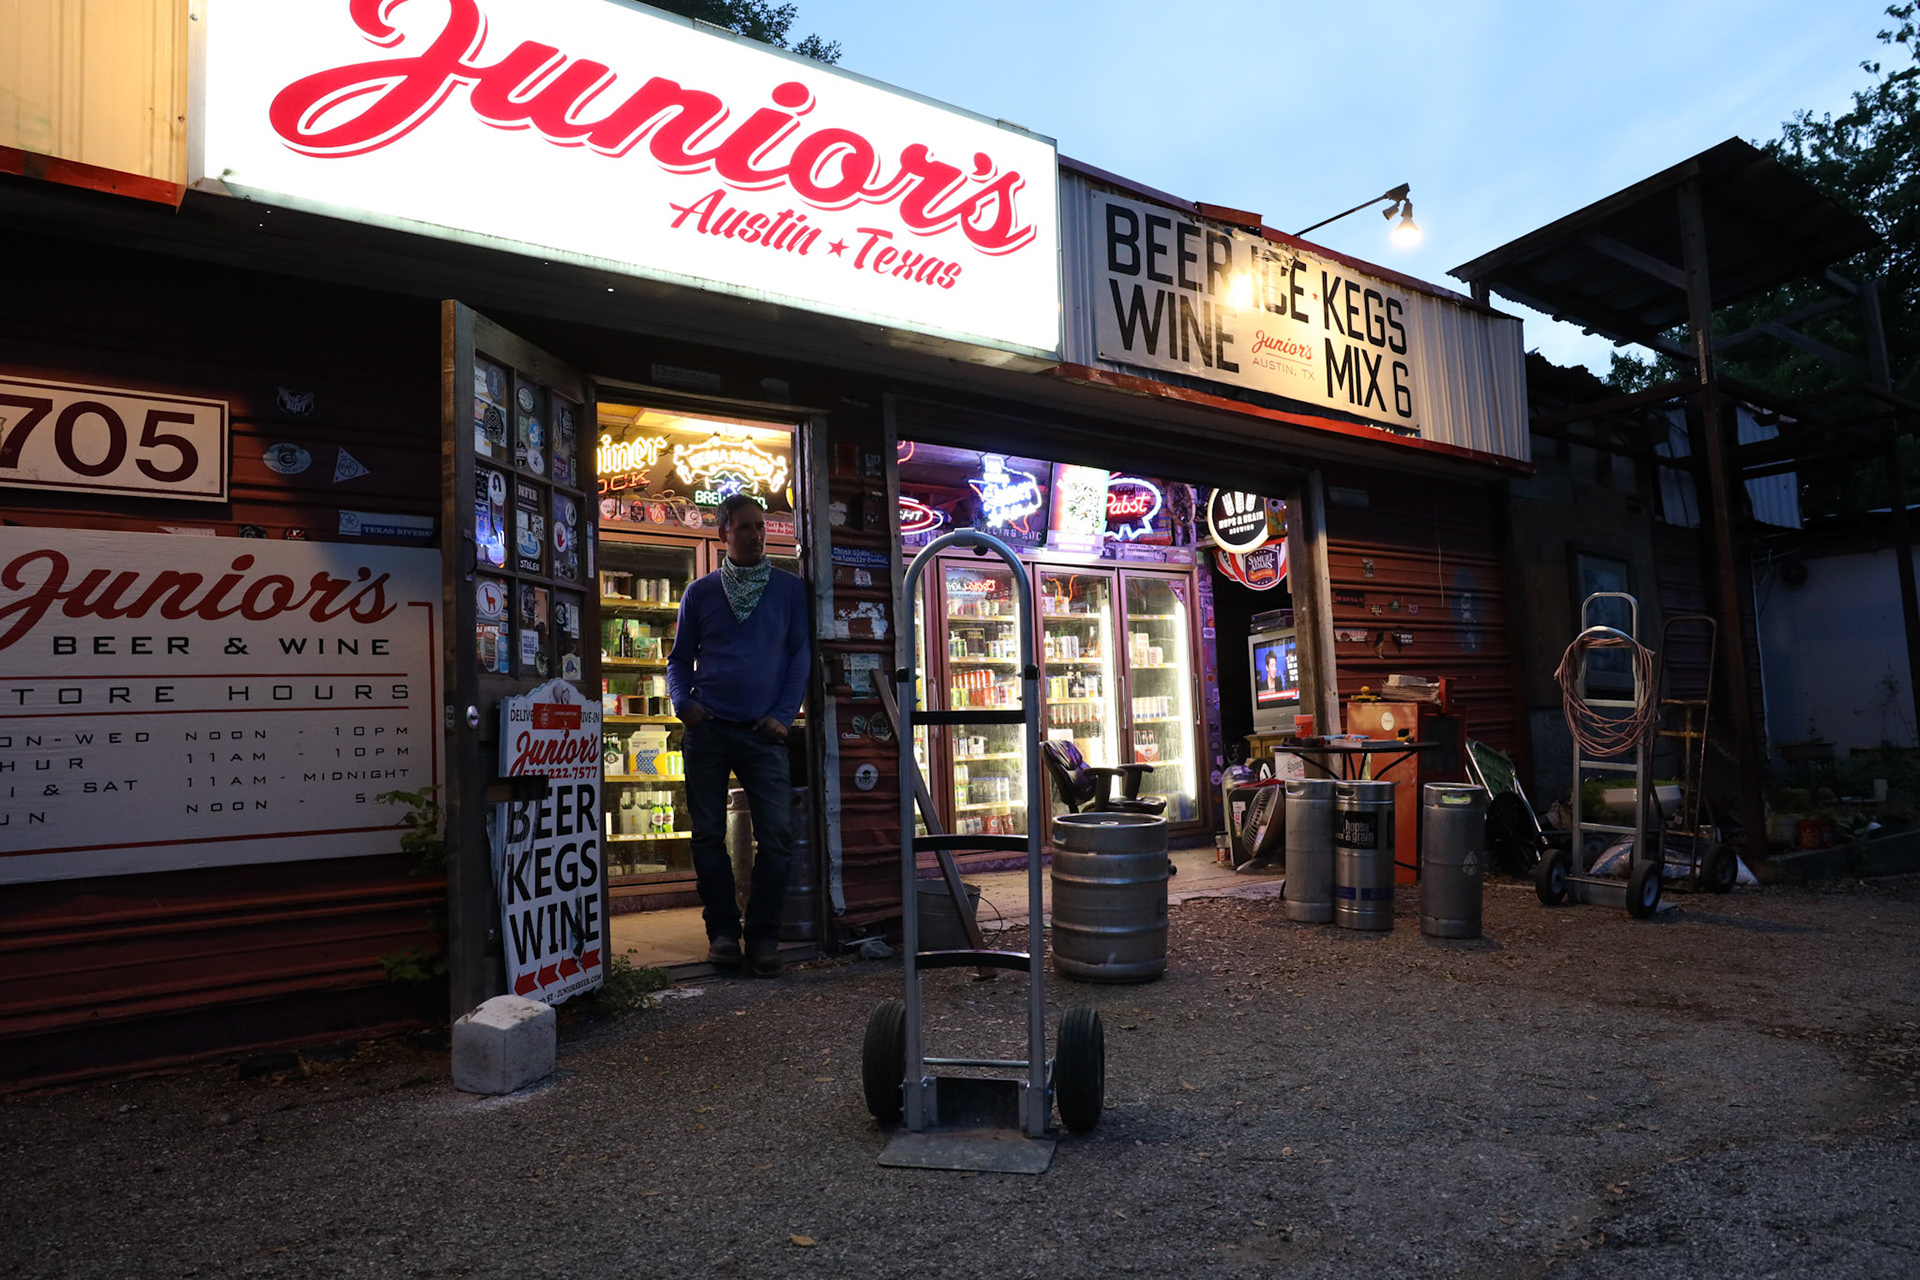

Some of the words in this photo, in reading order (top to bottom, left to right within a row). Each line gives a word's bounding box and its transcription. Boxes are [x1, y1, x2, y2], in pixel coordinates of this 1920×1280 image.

[269, 0, 1037, 256] Junior's
[669, 189, 822, 256] Austin
[853, 227, 963, 290] Texas
[1105, 202, 1233, 296] BEER
[1322, 271, 1408, 356] KEGS
[1108, 278, 1240, 374] WINE
[1324, 337, 1388, 413] MIX
[1392, 361, 1413, 419] 6
[1251, 330, 1313, 361] Junior's
[1302, 368, 1316, 382] TX
[597, 434, 668, 475] iner
[598, 469, 650, 494] OCK
[1106, 492, 1151, 514] Pabst
[899, 510, 924, 521] GHT
[1218, 516, 1237, 530] HOPS
[364, 527, 395, 535] TEXAS
[980, 525, 1017, 538] OLLING
[832, 547, 852, 555] Think
[1248, 553, 1275, 566] SAMUEL
[1251, 560, 1274, 573] ADAMS
[0, 549, 398, 651] Junior's
[53, 636, 190, 656] BEER
[224, 637, 249, 655] &
[278, 638, 390, 655] WINE
[11, 686, 175, 705] TORE
[229, 684, 409, 702] HOURS
[510, 709, 534, 722] DELIVE
[0, 731, 150, 748] ON-WED
[185, 729, 267, 742] NOON
[334, 726, 409, 737] 10PM
[0, 758, 84, 772] HUR
[186, 751, 267, 764] 11AM
[335, 747, 409, 758] 10PM
[509, 729, 599, 777] Junior's
[43, 784, 60, 797] &
[83, 780, 139, 793] SAT
[186, 775, 267, 788] 11AM
[304, 768, 410, 782] MIDNIGHT
[0, 812, 46, 826] UN
[185, 800, 268, 814] NOON
[508, 784, 598, 844] BEER
[1345, 819, 1366, 833] hops
[1352, 832, 1374, 844] grain
[507, 839, 598, 905] KEGS
[509, 893, 599, 966] WINE
